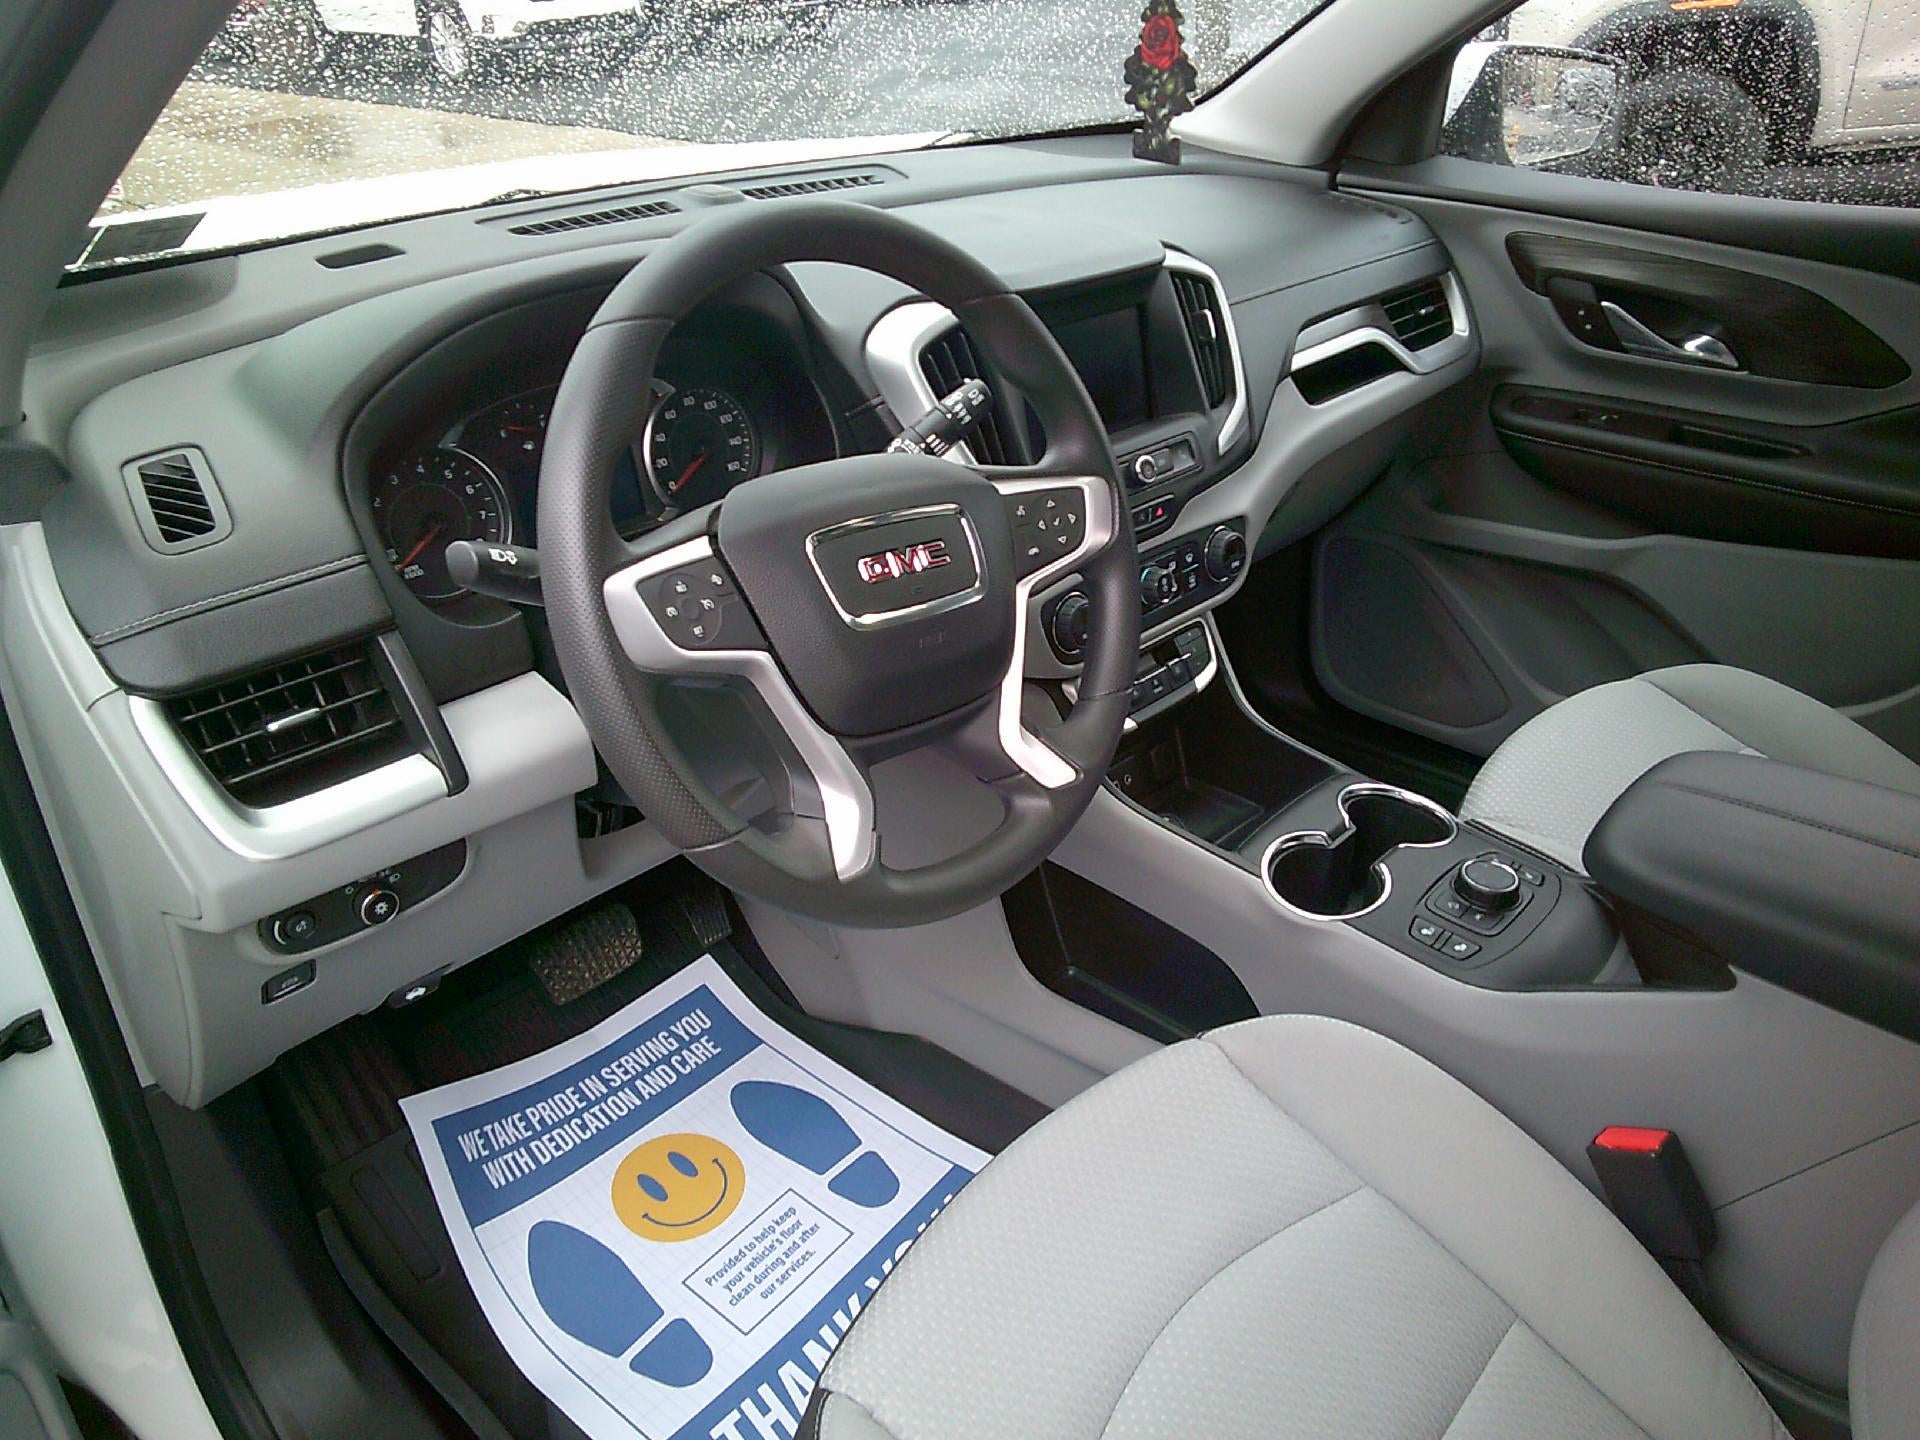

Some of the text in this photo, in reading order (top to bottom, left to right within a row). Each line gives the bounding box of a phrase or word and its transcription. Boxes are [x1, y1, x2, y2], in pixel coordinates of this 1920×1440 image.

[858, 540, 951, 583] GMC
[457, 1008, 712, 1163] WE TAKE PRIDE IN SERVING YOU
[482, 1035, 722, 1190] WITH DEDICATION AND CARE
[704, 1206, 797, 1287] Provided to help keep
[723, 1219, 803, 1293] your vehicle's floor
[728, 1222, 821, 1307] clean during and after
[760, 1249, 817, 1300] our services.
